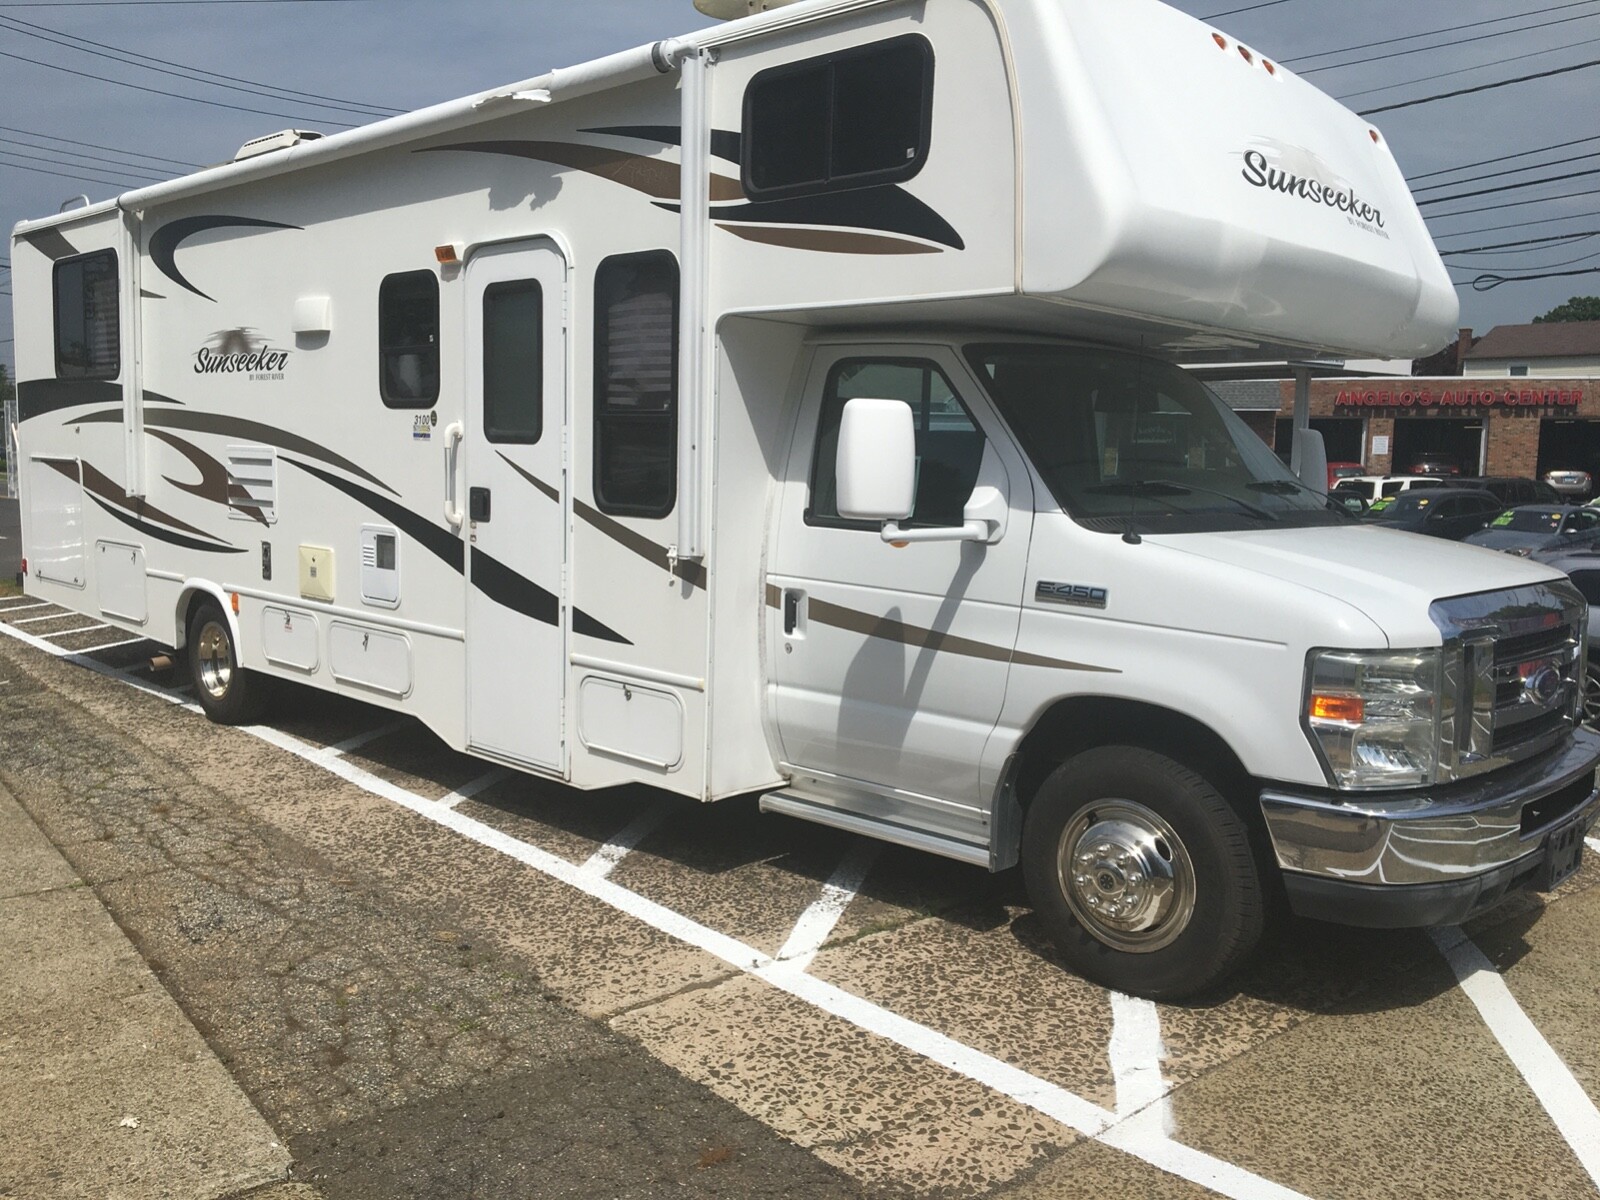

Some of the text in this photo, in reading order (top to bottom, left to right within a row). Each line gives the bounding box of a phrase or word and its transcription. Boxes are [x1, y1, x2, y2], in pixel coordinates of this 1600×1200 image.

[1242, 149, 1385, 228] Sunseeker
[194, 345, 288, 373] Sunseeker
[1335, 390, 1583, 406] ANGELO'S AUTO CENTER
[414, 414, 430, 425] 3100
